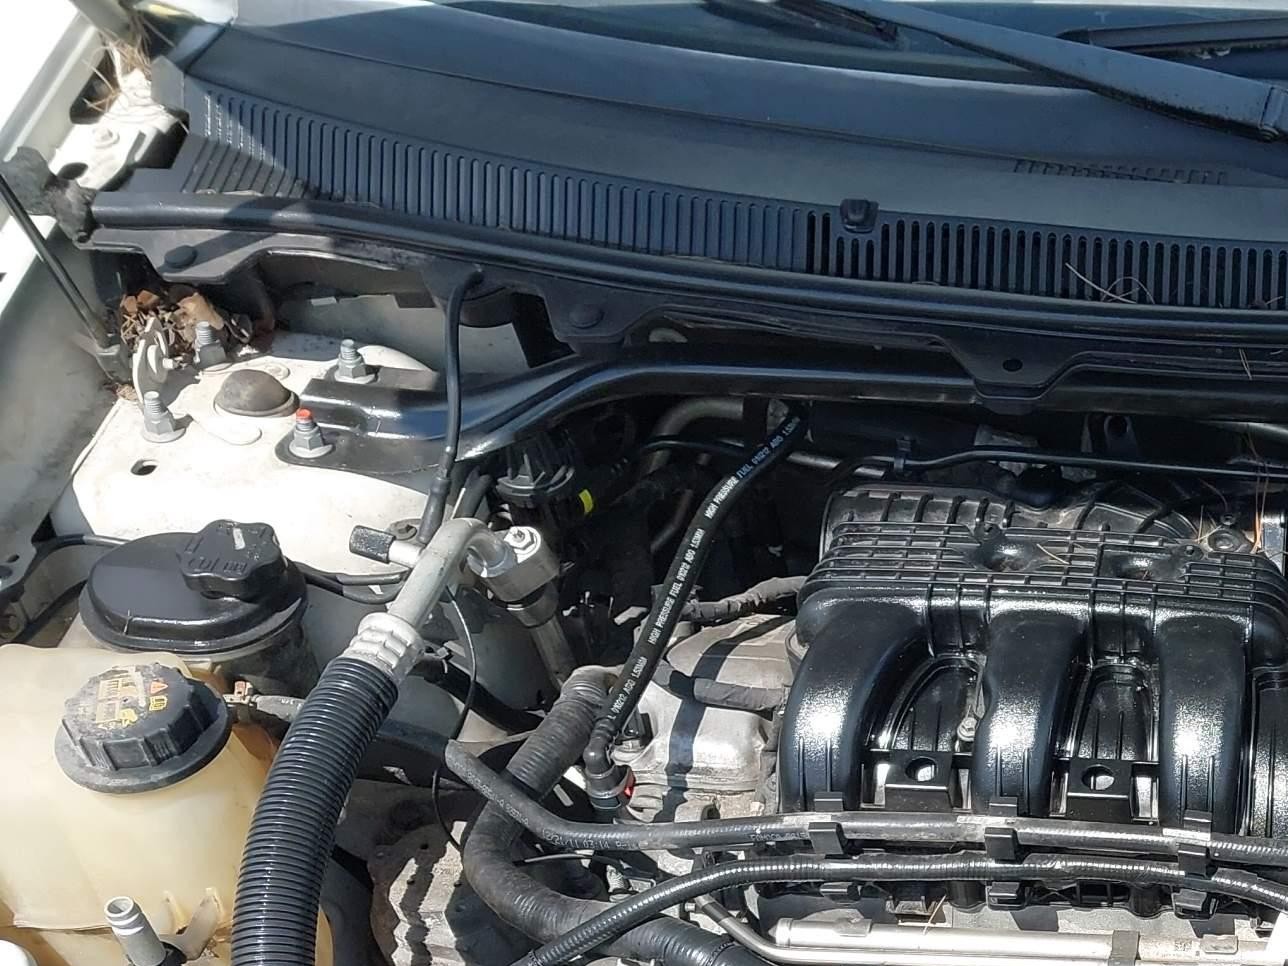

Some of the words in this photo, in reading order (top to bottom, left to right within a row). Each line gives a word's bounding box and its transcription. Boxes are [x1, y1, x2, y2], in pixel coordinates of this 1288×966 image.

[713, 476, 740, 505] PRESSURE
[655, 596, 676, 628] PRESSURE
[669, 582, 683, 598] FUEL
